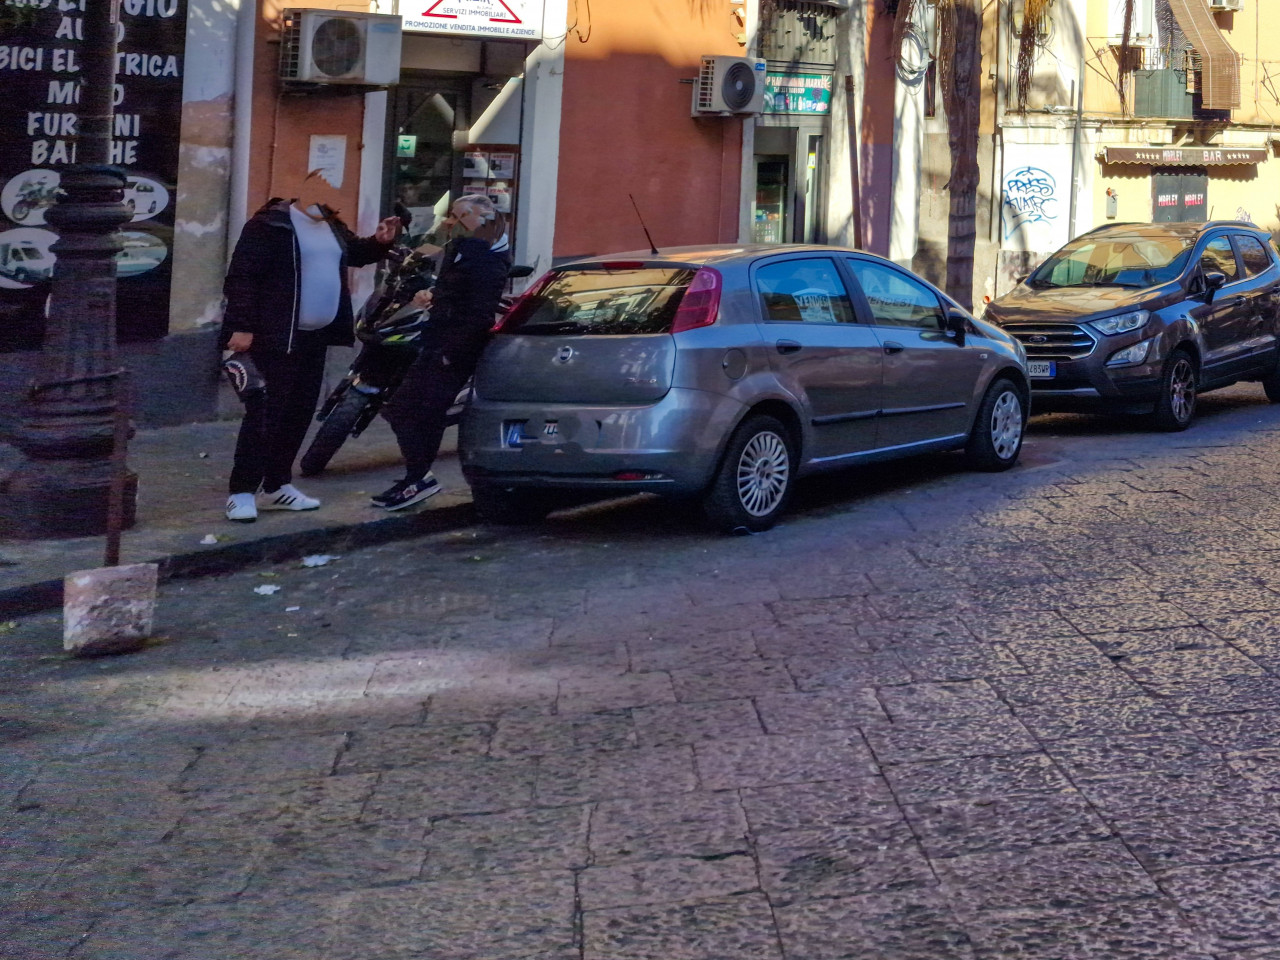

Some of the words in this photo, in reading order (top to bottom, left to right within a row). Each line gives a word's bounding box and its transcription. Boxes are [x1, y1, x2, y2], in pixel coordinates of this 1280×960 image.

[442, 7, 467, 15] SERVIZI
[468, 10, 507, 18] IMMOBILIARI
[404, 20, 448, 30] PROMOZIONE
[449, 23, 476, 32] VENDITA
[477, 25, 506, 33] IMMOBILI
[511, 28, 536, 36] AZIENDE
[0, 45, 44, 71] BICI
[52, 49, 179, 77] ELTRICA
[47, 80, 125, 107] MO
[27, 112, 140, 137] FURNI
[31, 140, 139, 166] BAHE
[1203, 150, 1222, 162] BAR
